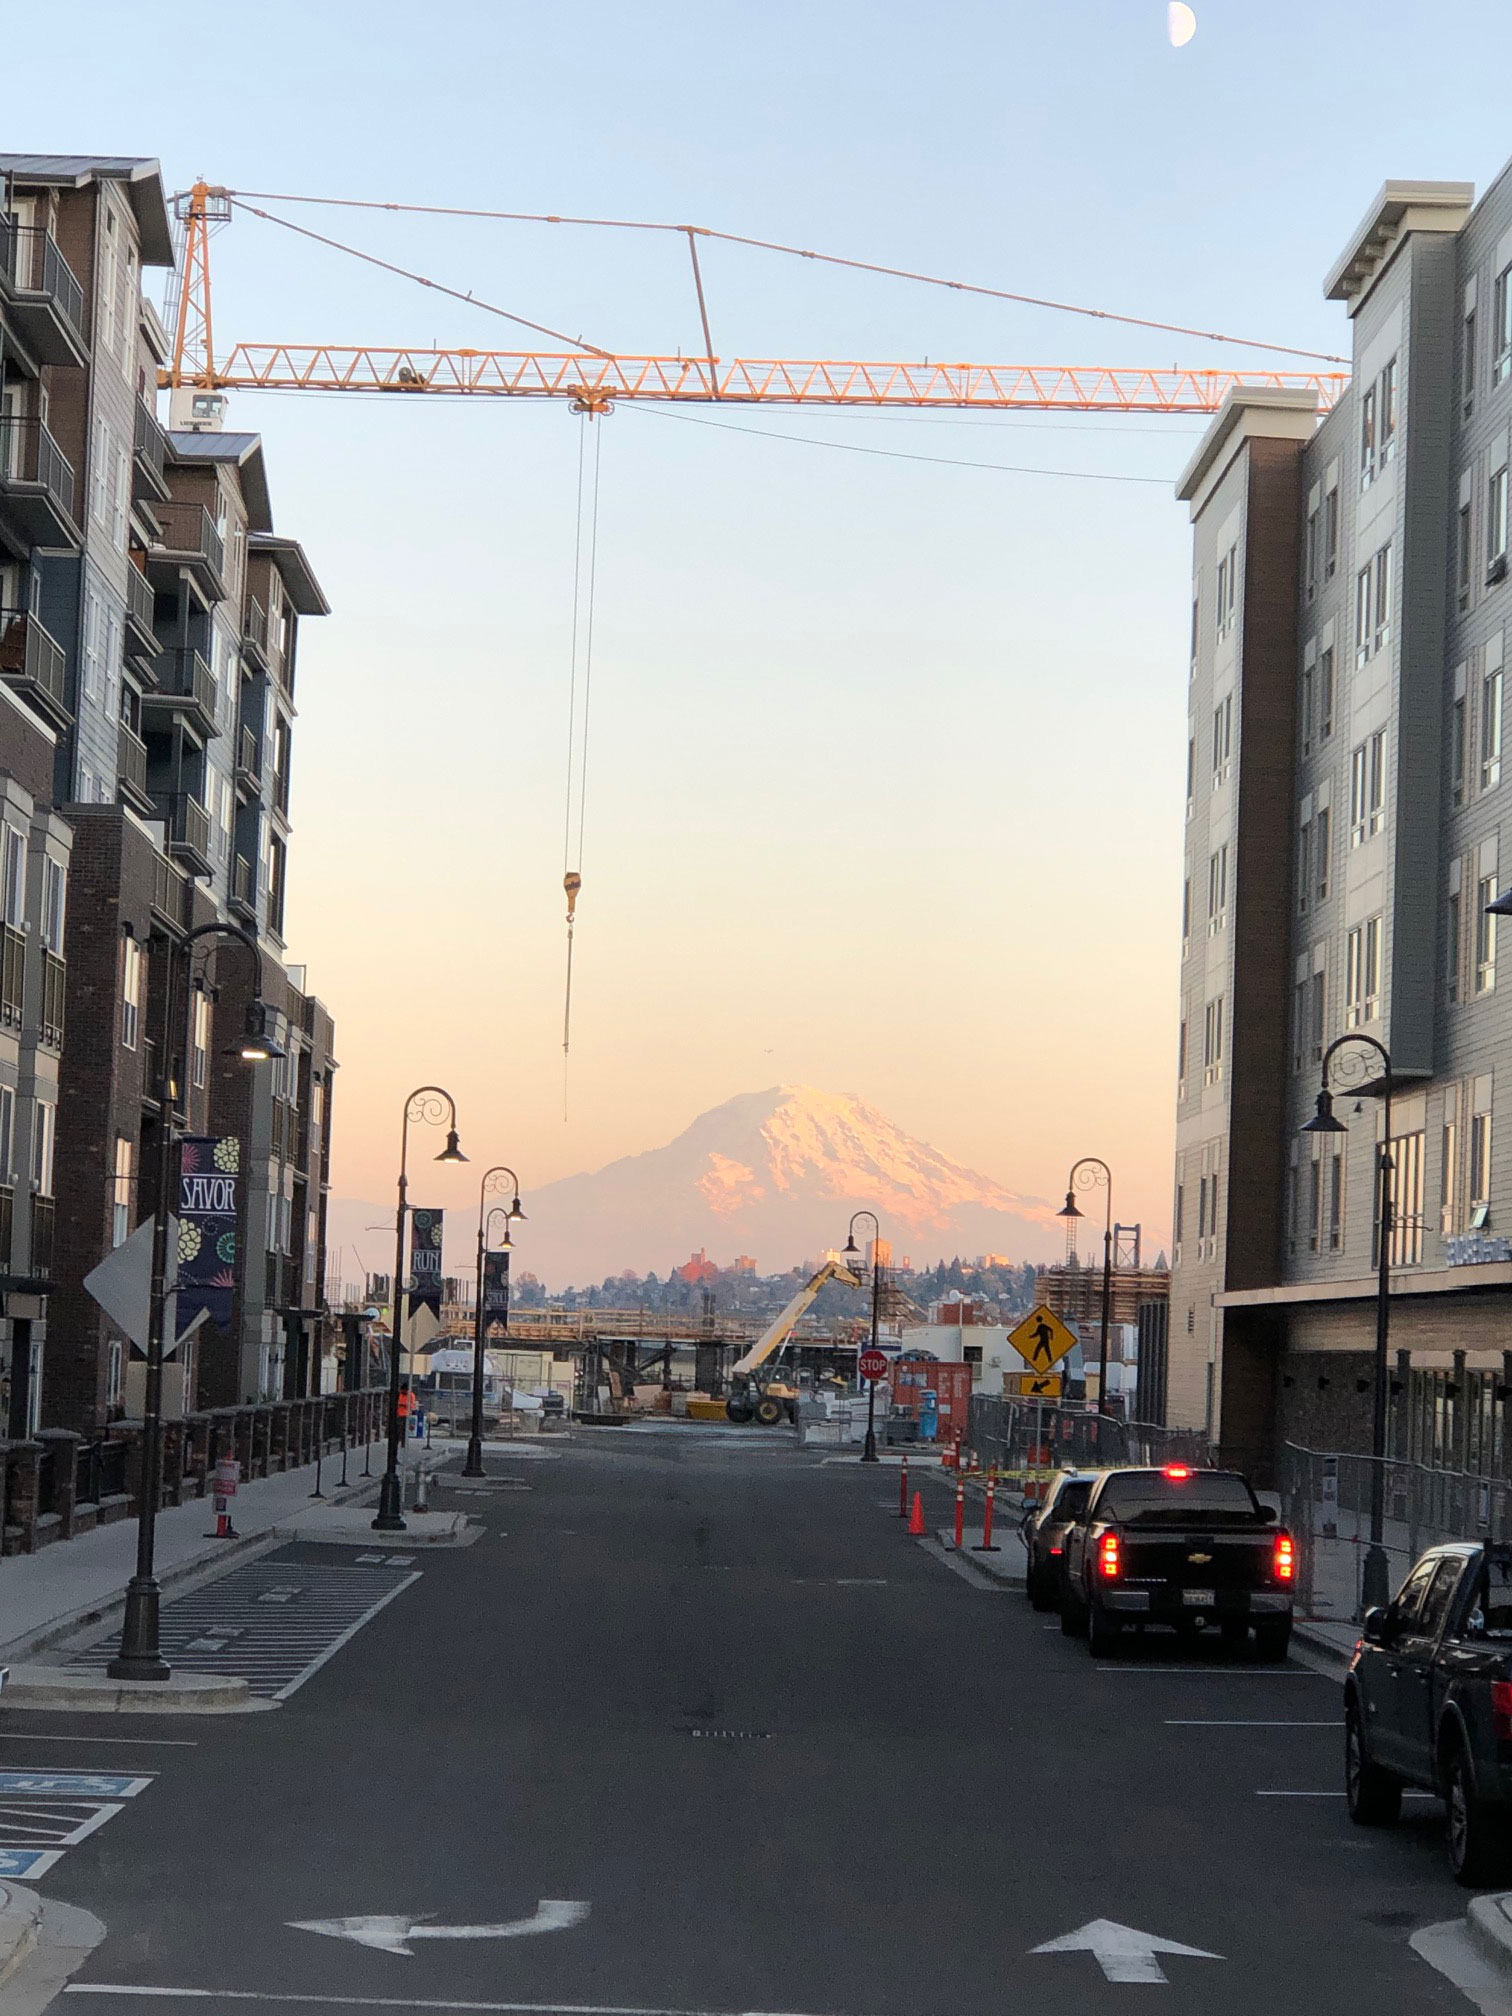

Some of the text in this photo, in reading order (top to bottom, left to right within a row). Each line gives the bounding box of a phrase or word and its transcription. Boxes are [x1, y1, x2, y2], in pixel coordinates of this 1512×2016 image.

[181, 1178, 236, 1210] SAVOR
[412, 1251, 439, 1271] RUN
[860, 1359, 886, 1372] STOP
